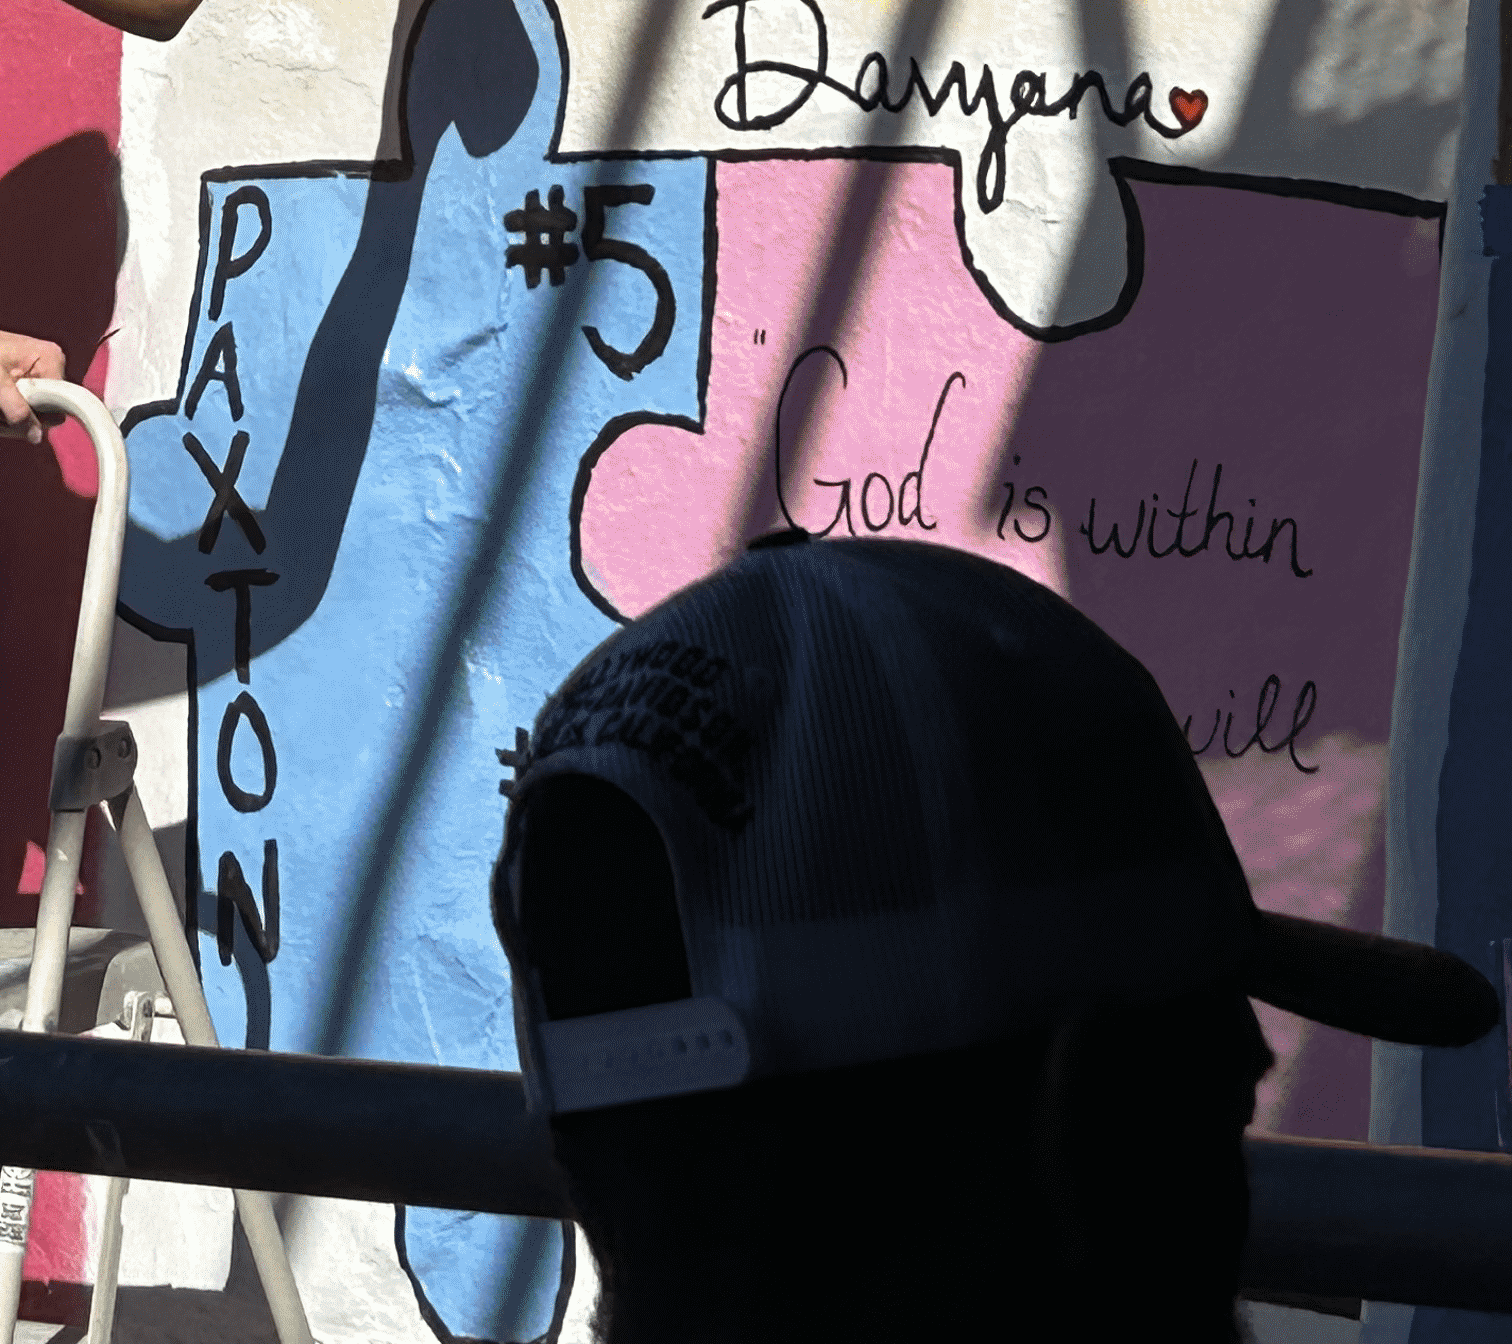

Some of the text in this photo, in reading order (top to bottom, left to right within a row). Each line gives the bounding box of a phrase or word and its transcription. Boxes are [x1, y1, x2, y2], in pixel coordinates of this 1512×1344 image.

[503, 182, 677, 381] #5
[182, 183, 281, 967] PAXTON
[995, 454, 1052, 543] is
[1080, 457, 1314, 579] within
